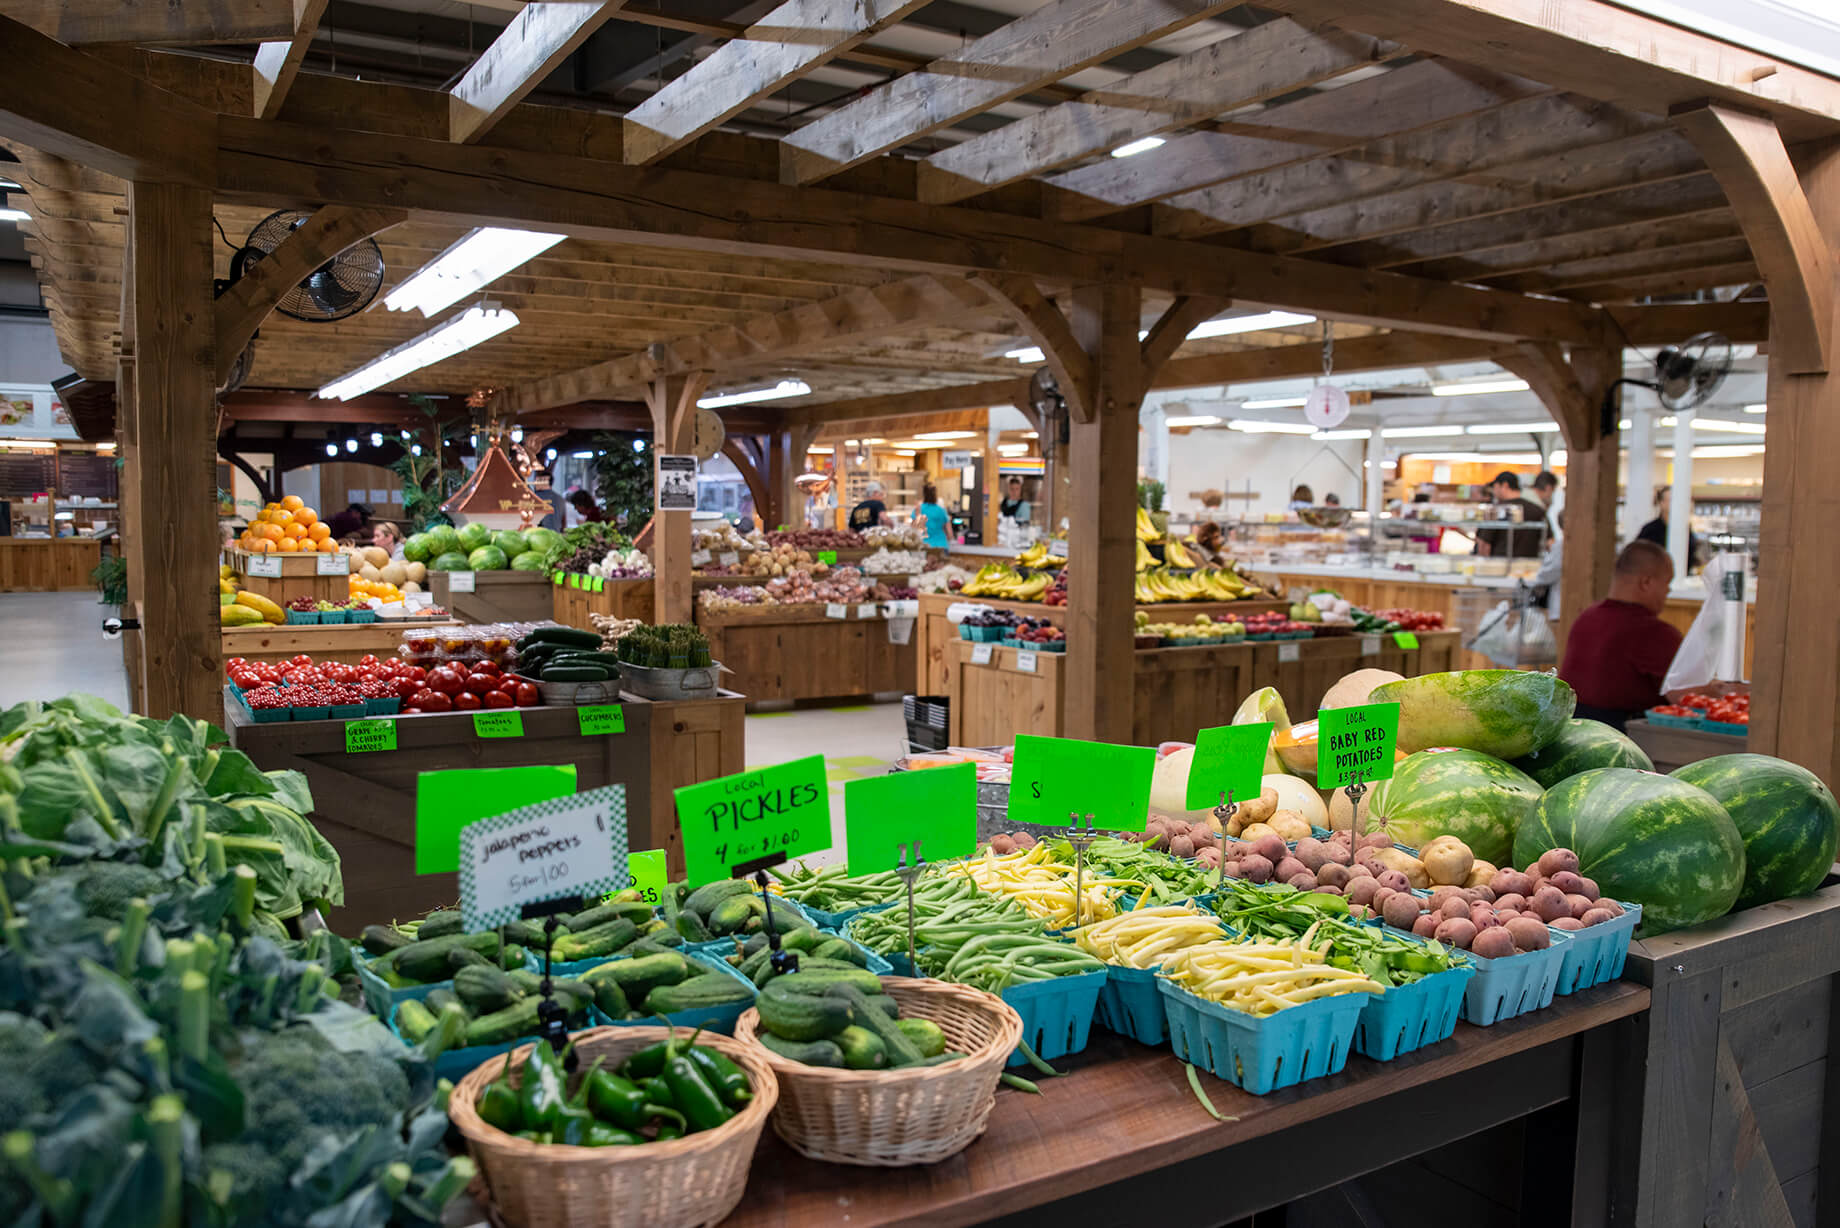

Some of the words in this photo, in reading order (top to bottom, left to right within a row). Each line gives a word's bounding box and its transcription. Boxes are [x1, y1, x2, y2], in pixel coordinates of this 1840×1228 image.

[1345, 711, 1367, 725] LOCAL
[1330, 731, 1358, 751] BABY
[1364, 727, 1386, 743] RED
[1336, 746, 1383, 768] POTATOES
[704, 783, 818, 832] PICKLES
[519, 834, 581, 864] peppers
[715, 843, 728, 864] 4
